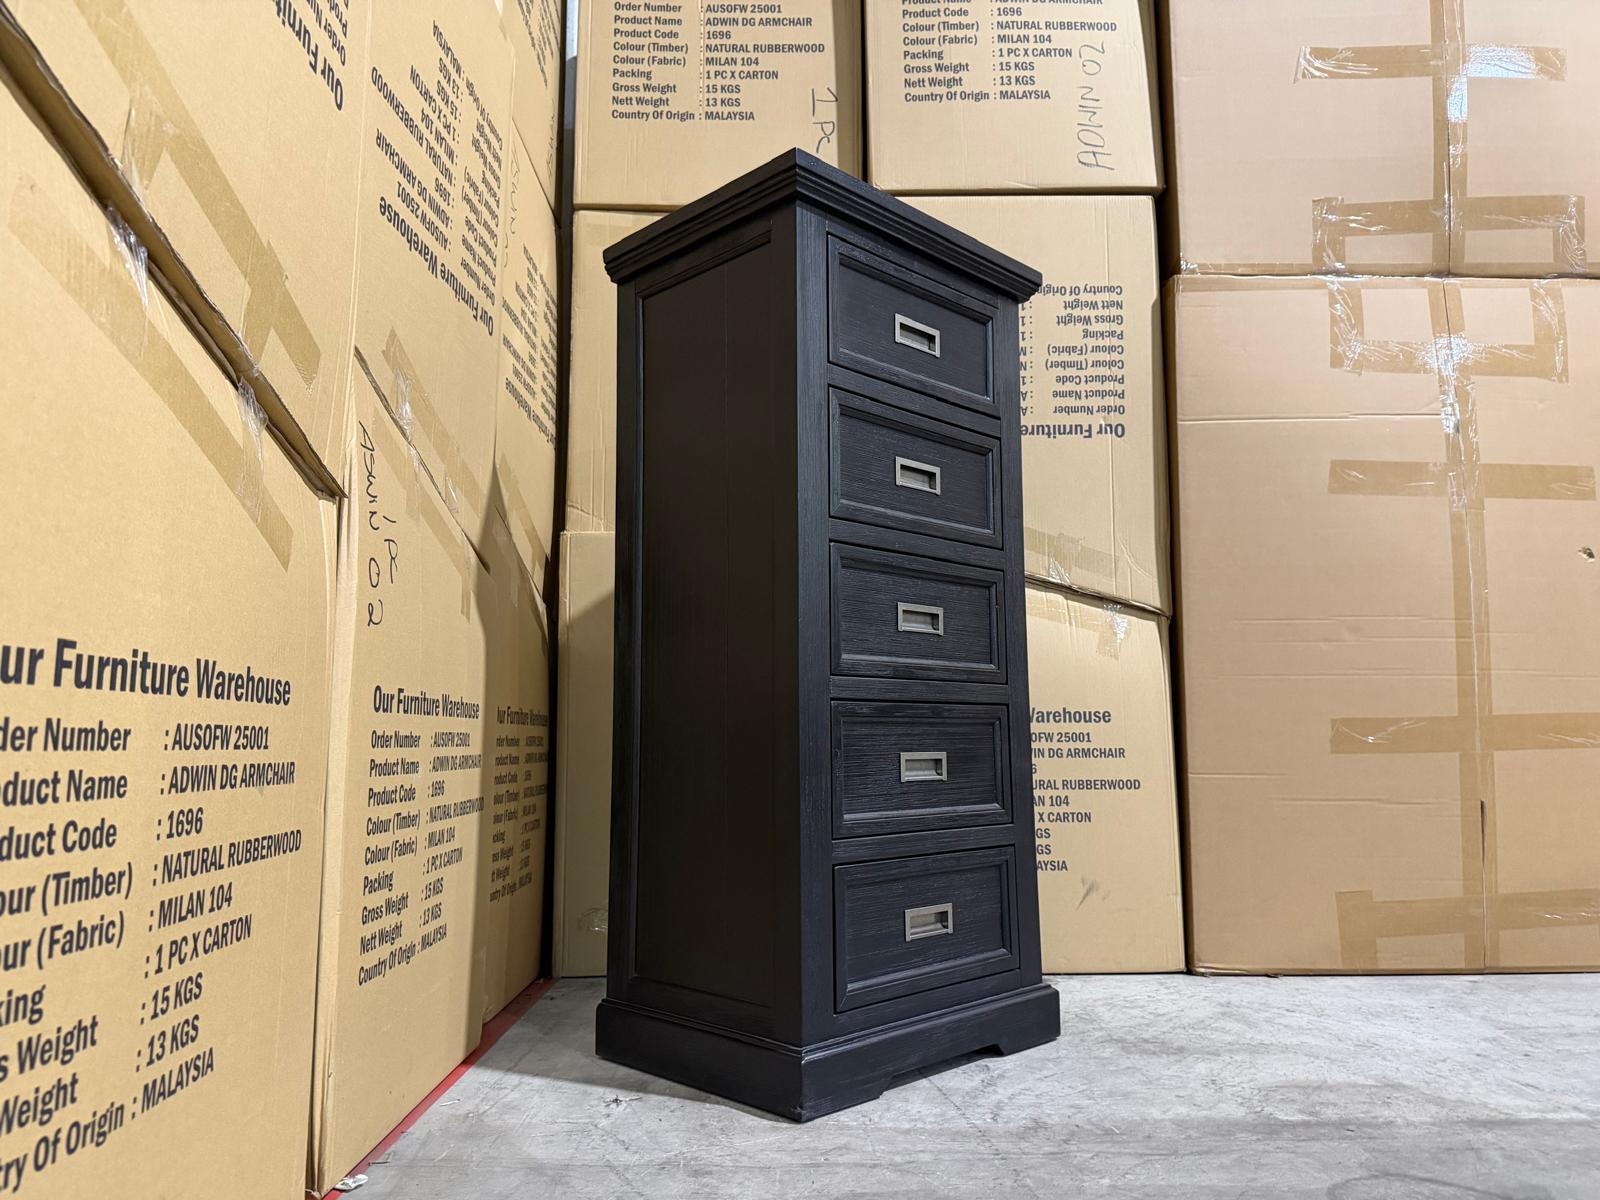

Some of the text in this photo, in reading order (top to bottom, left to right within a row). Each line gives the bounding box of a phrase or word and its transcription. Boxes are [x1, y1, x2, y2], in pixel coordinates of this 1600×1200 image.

[614, 1, 783, 13] Order Number AUSOFW 25001
[902, 7, 1022, 19] Product Code 1696
[614, 14, 813, 27] Product Name ADWIN DG ARMCHAIR
[902, 21, 1117, 33] Colour (Timber) NATURAL RUBBERWOOD
[613, 28, 732, 40] Product Code 1696
[903, 34, 1052, 47] Colour (Fabric) MILAN 104
[323, 18, 346, 67] Order
[433, 20, 461, 79] MALAYSIA
[613, 41, 825, 55] Colour (Timber) NATURAL RUBBERWOOD
[273, 0, 343, 111] Our Furnit
[612, 54, 759, 68] Colour (Fabric) MILAN 104
[903, 48, 1072, 60] Packing CARTON
[612, 68, 779, 81] Packing CARTON
[904, 61, 1035, 74] Gross Weight 15 KGS
[612, 82, 741, 95] Gross Weight 15 KGS
[904, 75, 1036, 89] Nett Weight 13 KGS
[410, 65, 437, 114] CARTON
[904, 90, 1051, 103] Country Of Origin MALAYSIA
[611, 96, 741, 108] Nett Weight 13 KGS
[611, 109, 755, 122] Country Of Origin MALAYSIA
[371, 66, 454, 186] NATURAL RUBBERWOOD
[421, 108, 455, 165] MILAN 104
[376, 128, 416, 188] ARMCHAIR
[397, 181, 448, 251] AUSOFW 25001
[379, 196, 494, 336] Our Furniture Warehouse
[1083, 329, 1124, 340] Packing
[1048, 344, 1124, 356] Colour (Fabric)
[1045, 359, 1124, 371] Colour (Timber)
[1056, 374, 1125, 385] Product Code
[1053, 389, 1125, 399] Product Name
[1053, 405, 1125, 415] Order Number
[1021, 423, 1125, 438] Our Furniture
[0, 638, 291, 706] ur Furniture Warehouse
[373, 685, 480, 719] Our Furniture Warehouse
[0, 716, 270, 752] der Number AUSOFW 25001
[371, 730, 421, 748] Order Number
[1056, 732, 1092, 743] 25001
[1048, 748, 1126, 759] DG ARMCHAIR
[369, 758, 420, 777] Product Name
[0, 761, 296, 807] duct Name ADWIN DG ARMCHAIR
[1062, 779, 1141, 790] RUBBERWOOD
[368, 785, 416, 807] Product Code
[1049, 795, 1070, 807] 104
[1047, 812, 1092, 823] CARTON
[0, 807, 204, 862] duct Code 1696
[41, 862, 133, 916] (Timber)
[162, 844, 225, 885] NATURAL
[228, 829, 302, 869] RUBBERWOOD
[1036, 860, 1068, 871] AYSIA
[363, 871, 394, 896] Packing
[361, 892, 409, 925] Gross Weight
[37, 910, 125, 970] (Fabric)
[158, 889, 205, 929] MILAN
[208, 881, 233, 913] 104
[154, 914, 252, 975] 1 PC X CARTON
[360, 921, 402, 956] Nett Weight
[358, 923, 447, 986] Country MALAYSIA
[17, 1015, 98, 1075] Weight
[151, 986, 170, 1020] 15
[173, 972, 203, 1016] KGS
[0, 1014, 200, 1136] Weight 13 KGS
[33, 1128, 61, 1173] Of
[65, 1102, 125, 1157] Origin
[141, 1047, 215, 1114] MALAYSIA
